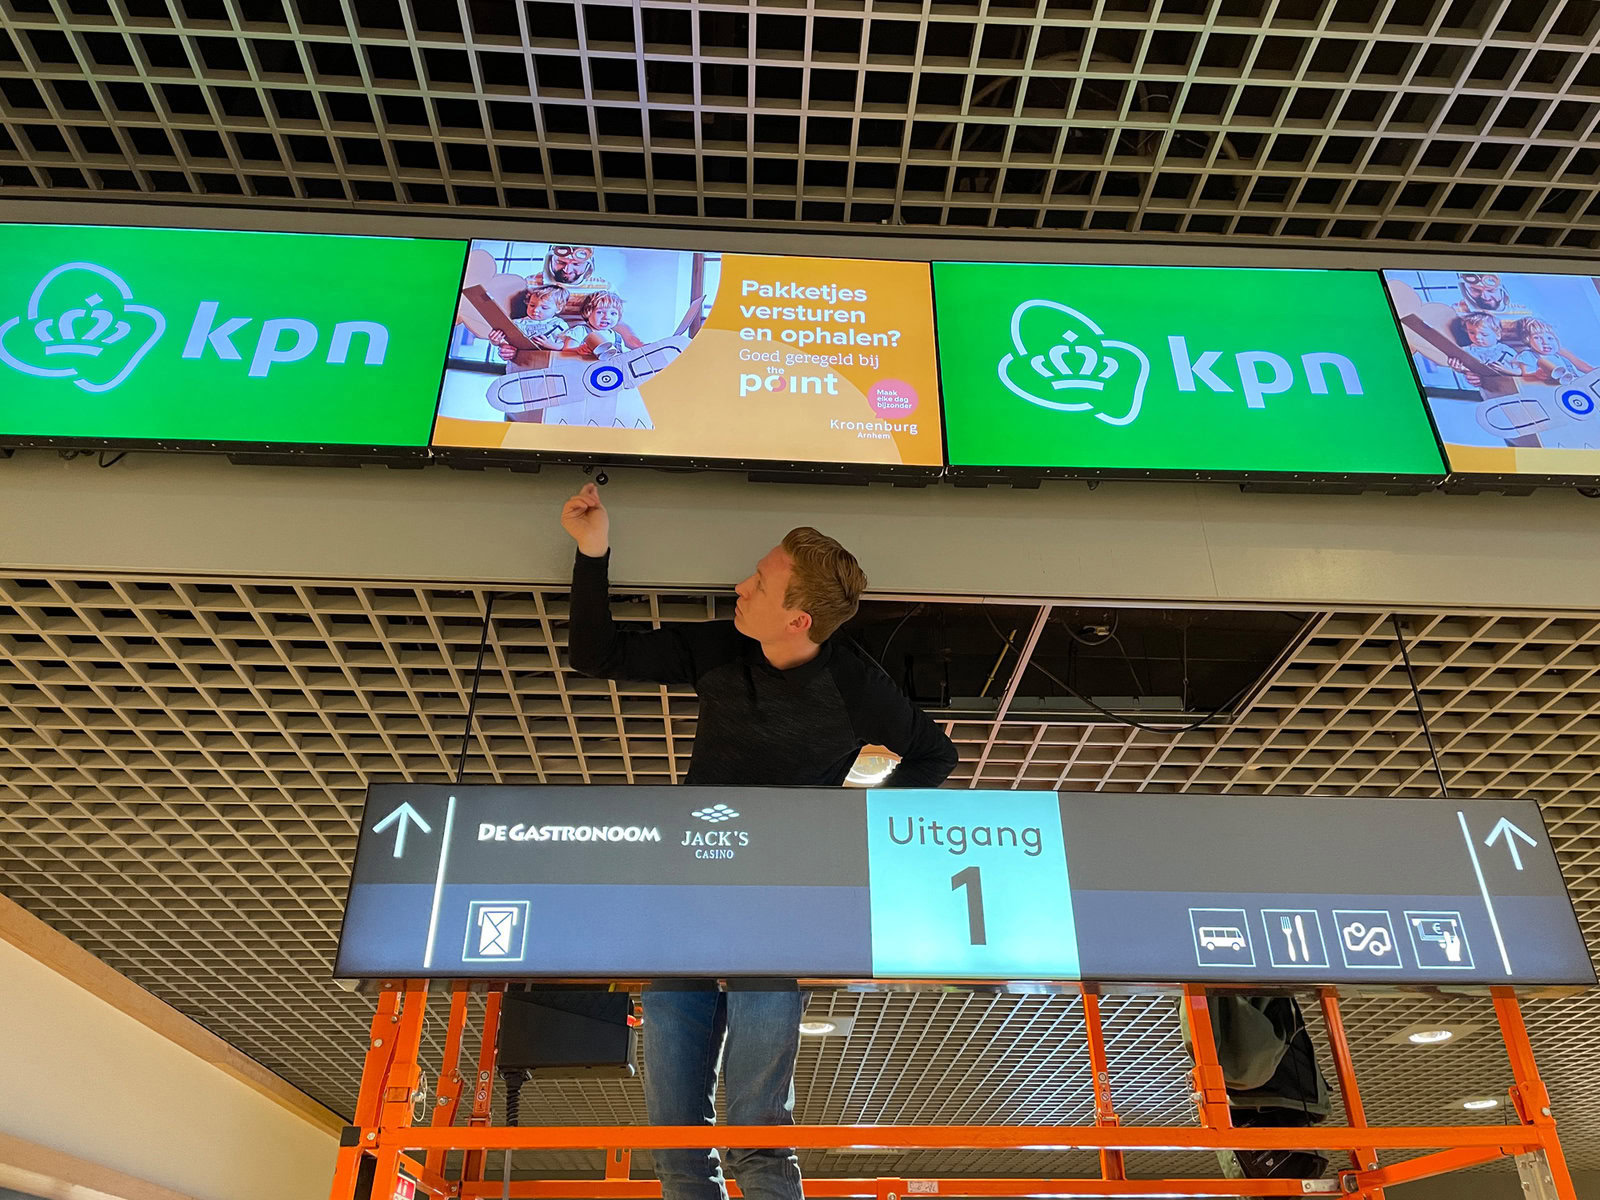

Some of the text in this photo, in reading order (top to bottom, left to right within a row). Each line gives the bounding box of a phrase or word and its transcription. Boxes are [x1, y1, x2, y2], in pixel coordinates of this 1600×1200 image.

[741, 280, 867, 304] Pakketjes
[739, 305, 866, 323] versturen
[182, 301, 389, 376] kpn
[739, 327, 901, 347] en ophalen?
[739, 349, 879, 369] Goed geregeld bij
[766, 366, 785, 375] the
[1167, 335, 1364, 408] kpn
[740, 373, 839, 397] point
[830, 419, 918, 434] Kronenburg
[478, 823, 661, 842] DE GASTRONOOM
[681, 831, 749, 847] JACK'S
[889, 816, 1042, 857] Uitgang
[695, 849, 734, 859] CASINO
[951, 866, 987, 945] 1
